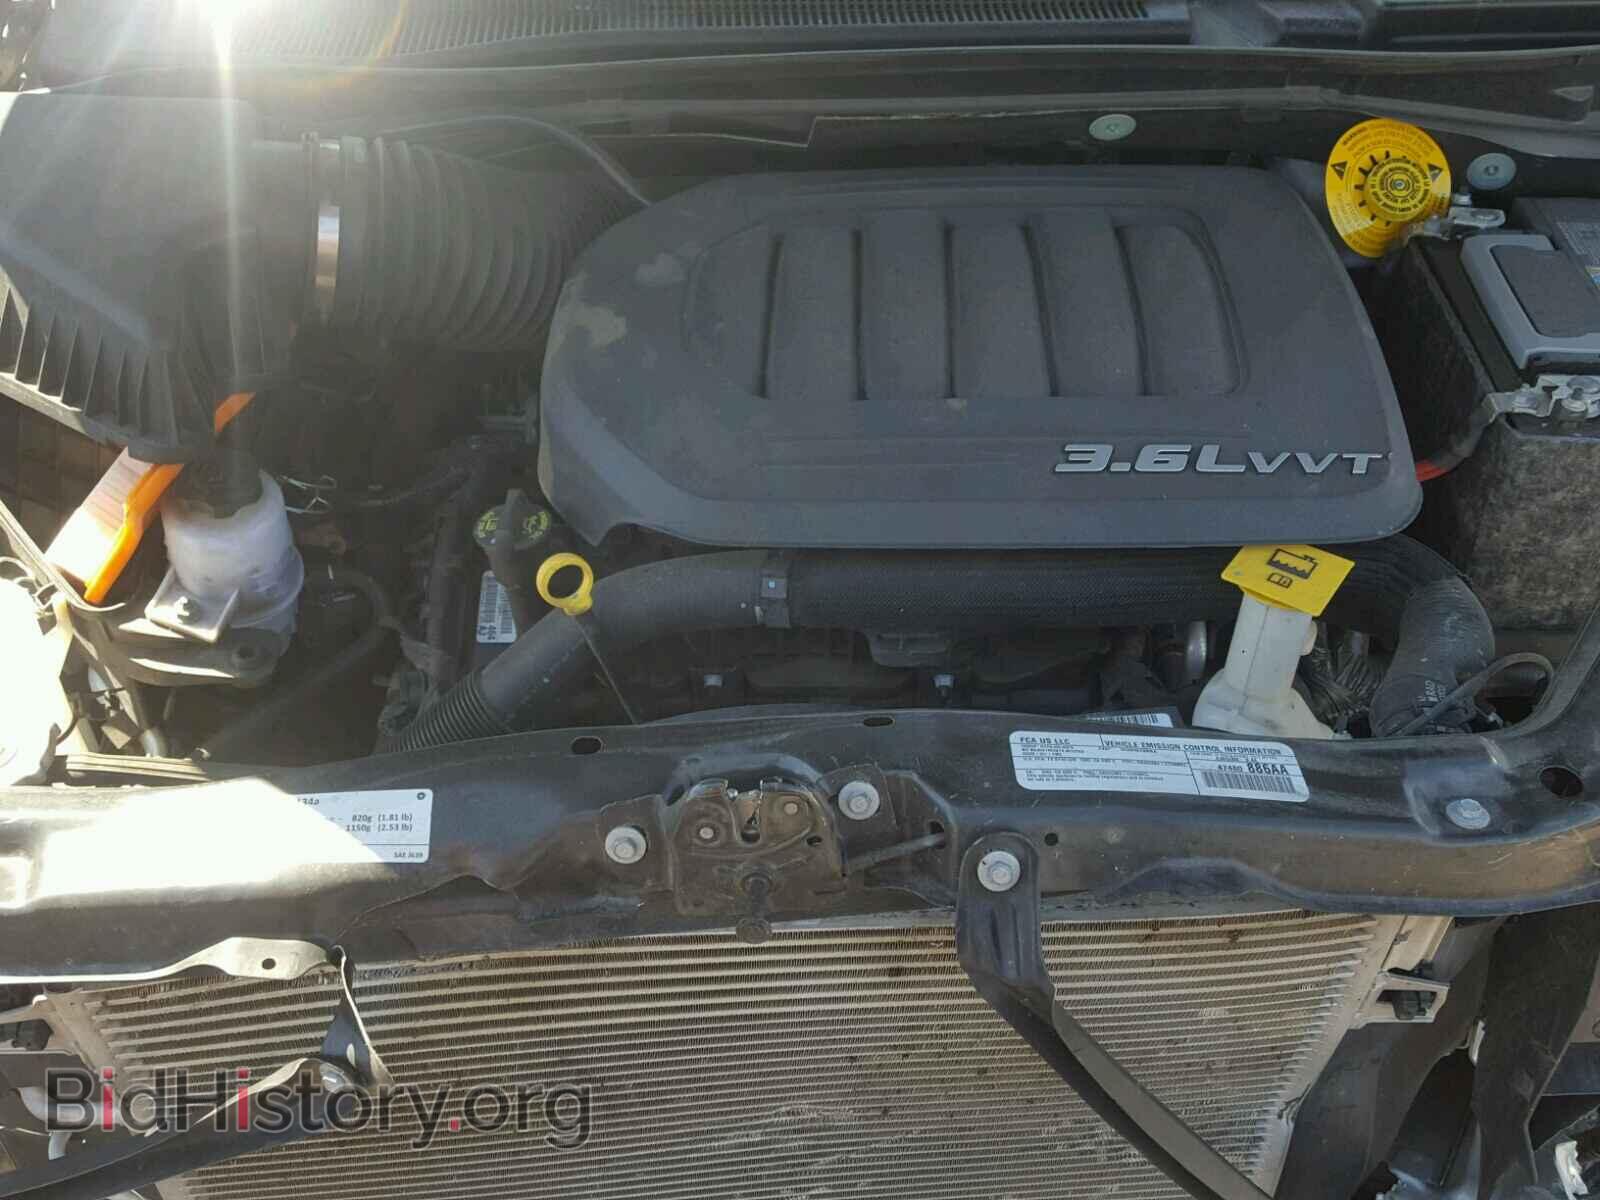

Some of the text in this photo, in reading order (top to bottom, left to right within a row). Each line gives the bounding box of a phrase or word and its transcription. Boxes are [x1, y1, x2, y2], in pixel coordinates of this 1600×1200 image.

[1104, 740, 1139, 749] VEHICLE
[1141, 742, 1181, 750] EMISSION
[1183, 744, 1220, 752] CONTROL
[1223, 745, 1282, 755] INFORMATION
